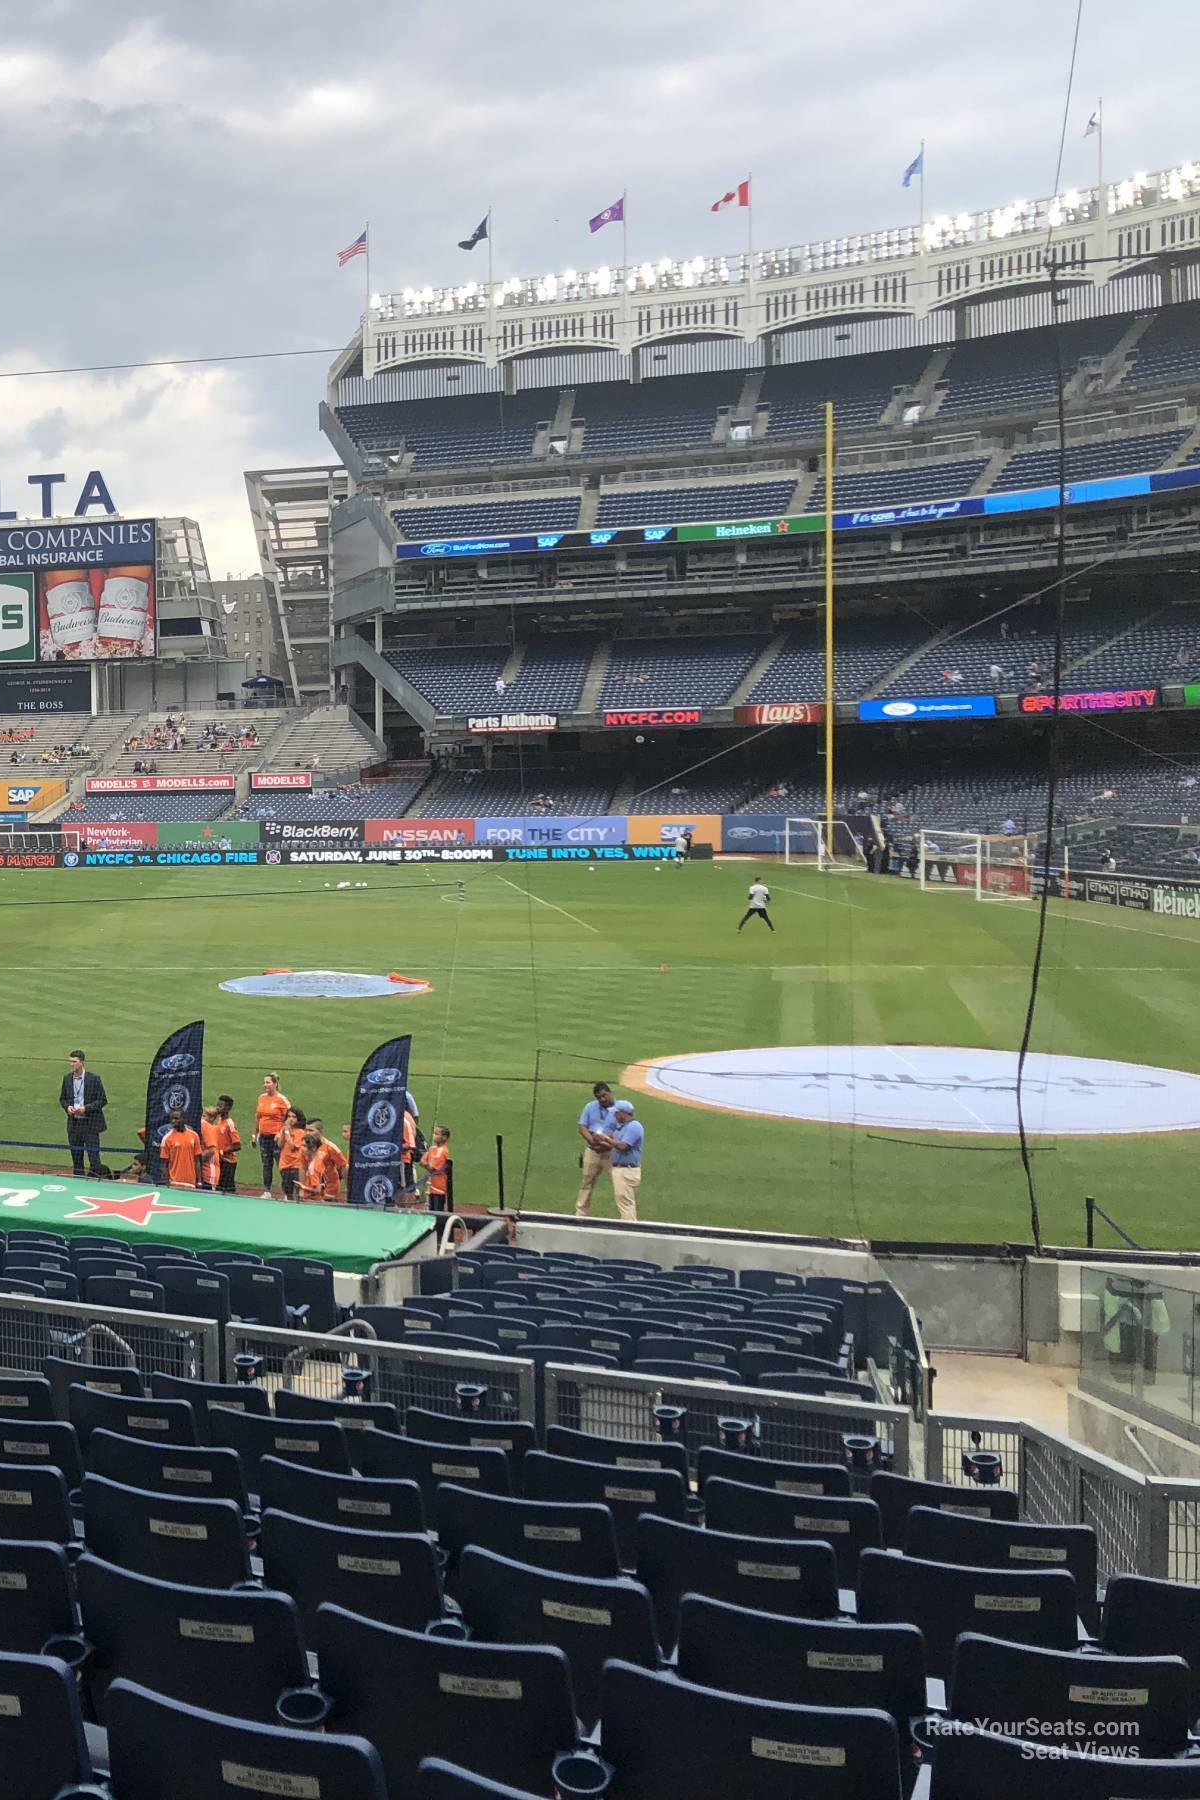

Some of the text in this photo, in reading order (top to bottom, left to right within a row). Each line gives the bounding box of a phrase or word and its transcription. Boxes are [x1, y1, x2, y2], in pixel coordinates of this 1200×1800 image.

[645, 530, 666, 541] SAP
[716, 523, 772, 537] Heineken
[8, 522, 153, 552] COMPANIES
[537, 537, 558, 548] SAP
[590, 533, 611, 544] SAP
[426, 542, 510, 554] Ford BuyFordNow.com
[27, 550, 104, 565] INSURANCE
[17, 701, 64, 710] THE BOSS
[1023, 690, 1155, 712] #FORTHECITY
[469, 714, 557, 728] Parts Authority
[606, 712, 700, 725] NYCFC.COM
[91, 777, 229, 789] MODELL'S MODELLS.com
[257, 776, 306, 786] MODELL'S
[8, 789, 35, 802] SAP
[87, 827, 130, 836] NewYork-
[282, 826, 357, 840] BlackBerry
[487, 828, 607, 841] FOR THE CITY
[7, 855, 56, 867] MATCH
[86, 853, 134, 865] NYCFC
[157, 852, 222, 864] CHICAGO
[226, 852, 258, 863] FIRE
[290, 850, 364, 863] SATURDAY,
[365, 850, 401, 862] JUNE
[506, 848, 548, 859] TUNE
[551, 848, 591, 859] INTO
[594, 847, 629, 860] YES,
